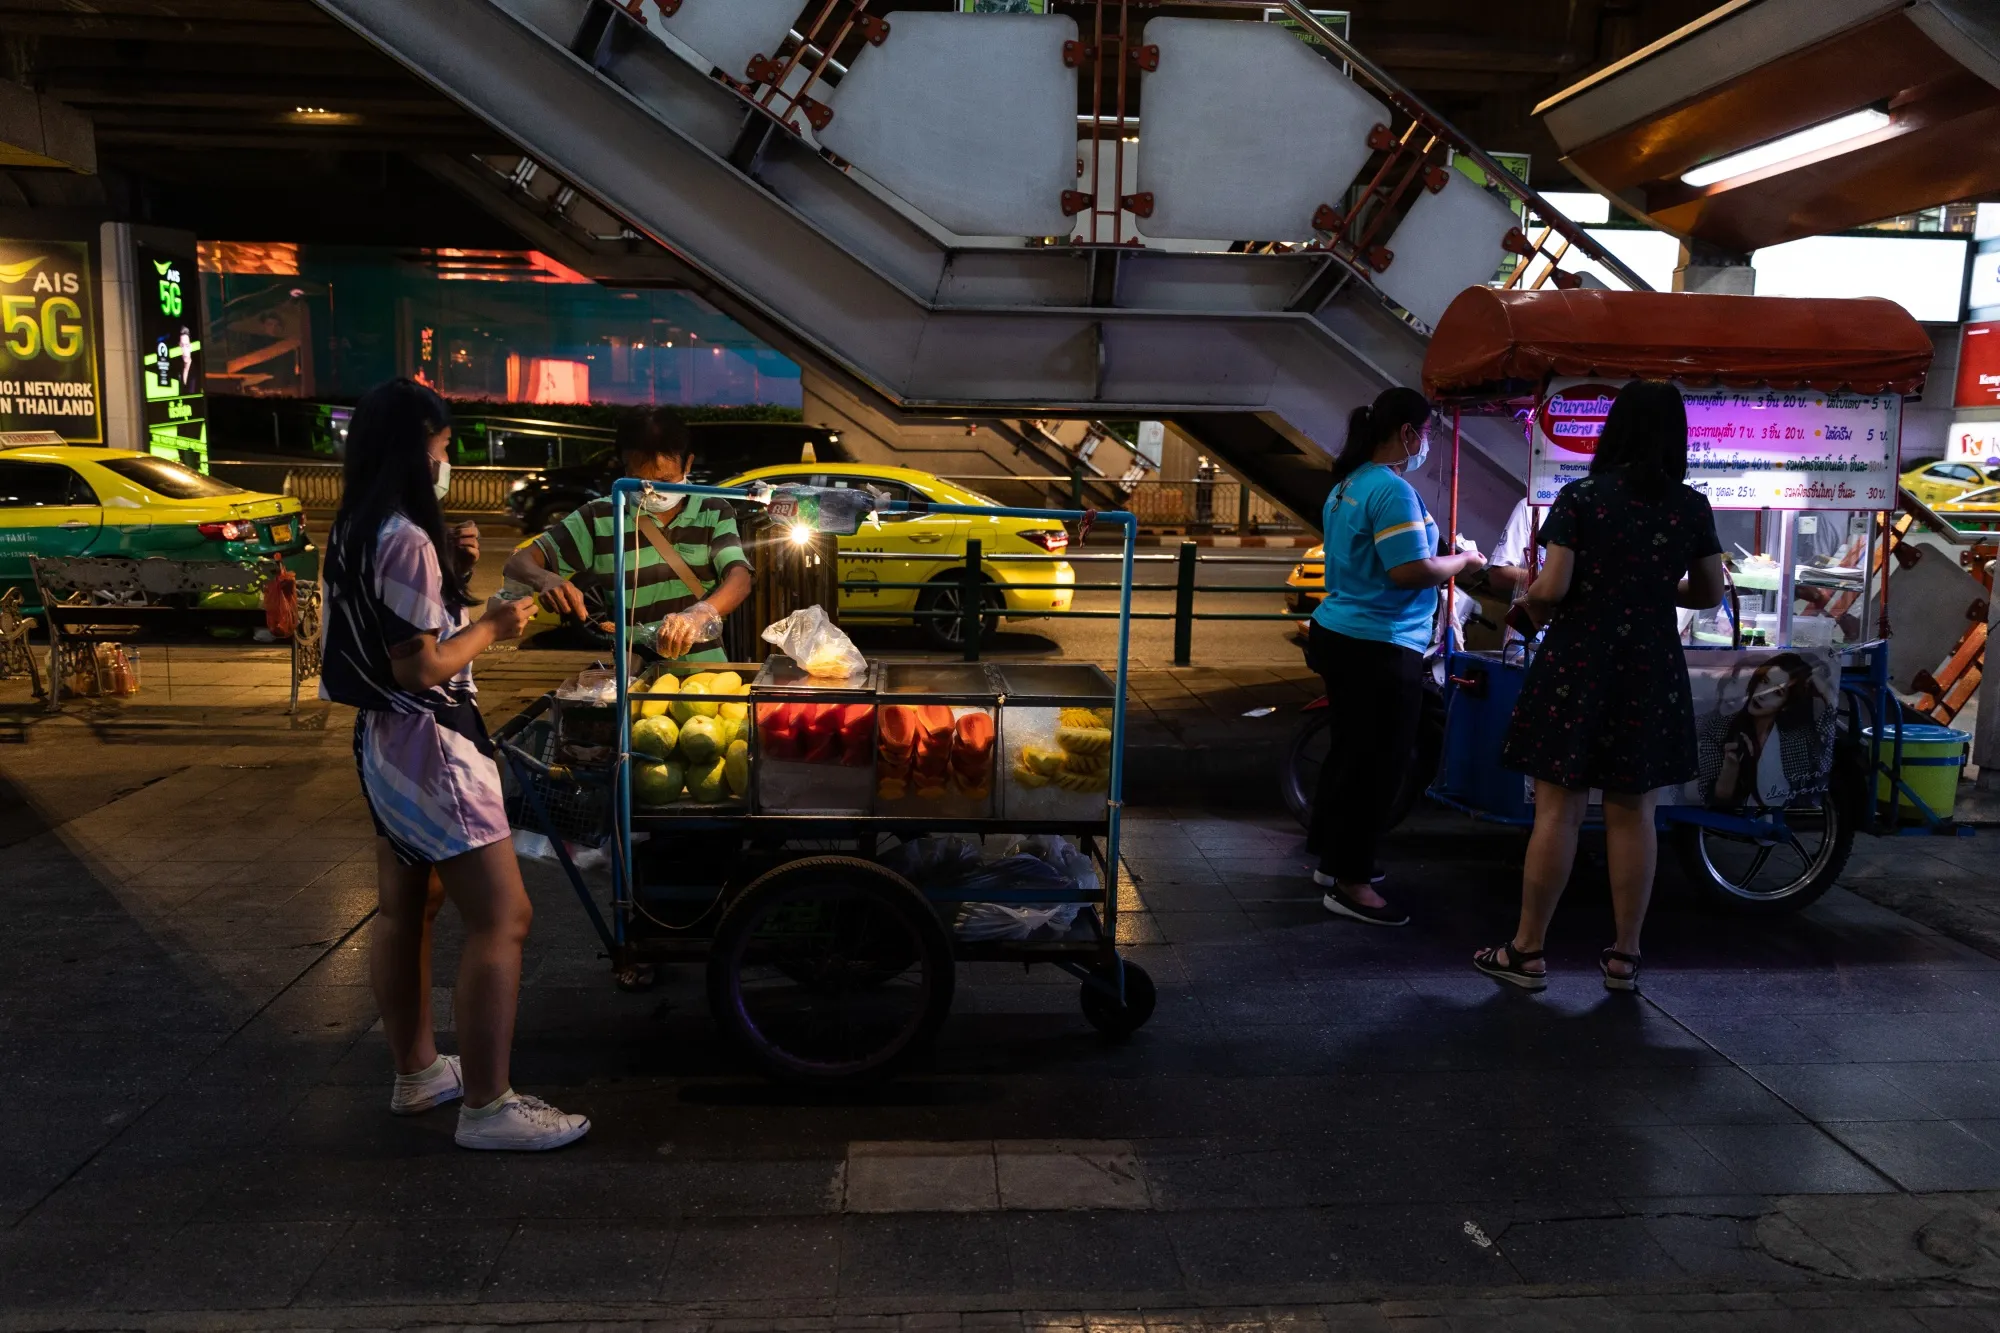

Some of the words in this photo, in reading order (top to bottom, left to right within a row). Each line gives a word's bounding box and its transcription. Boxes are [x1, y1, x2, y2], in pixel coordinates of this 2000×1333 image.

[1512, 167, 1523, 177] 5G
[33, 271, 79, 294] AIS
[167, 269, 180, 283] AIS
[159, 280, 182, 317] 5G
[1, 295, 84, 360] 5G
[25, 381, 93, 398] NETWORK
[0, 398, 12, 414] N
[16, 398, 95, 416] THAILAND
[1550, 396, 1611, 413] ร้านขนมโต
[1683, 391, 1726, 411] รอกหมูสับ
[1733, 394, 1740, 407] 7
[1757, 395, 1764, 407] 3
[1766, 391, 1779, 407] ชิ้น
[1783, 395, 1796, 407] 20
[1871, 398, 1878, 409] 5
[1556, 420, 1592, 434] แม่อาย
[1740, 427, 1745, 438] 7
[1761, 427, 1767, 439] 3
[1770, 423, 1780, 439] ชิ้น
[1785, 427, 1796, 439] 20
[1825, 425, 1852, 440] ไส้ครีม
[1867, 429, 1874, 441] 5
[1692, 443, 1700, 452] 12
[1751, 457, 1762, 470] 40
[1738, 486, 1747, 497] 25
[6, 534, 25, 542] TAXI
[839, 548, 883, 563] TAXI
